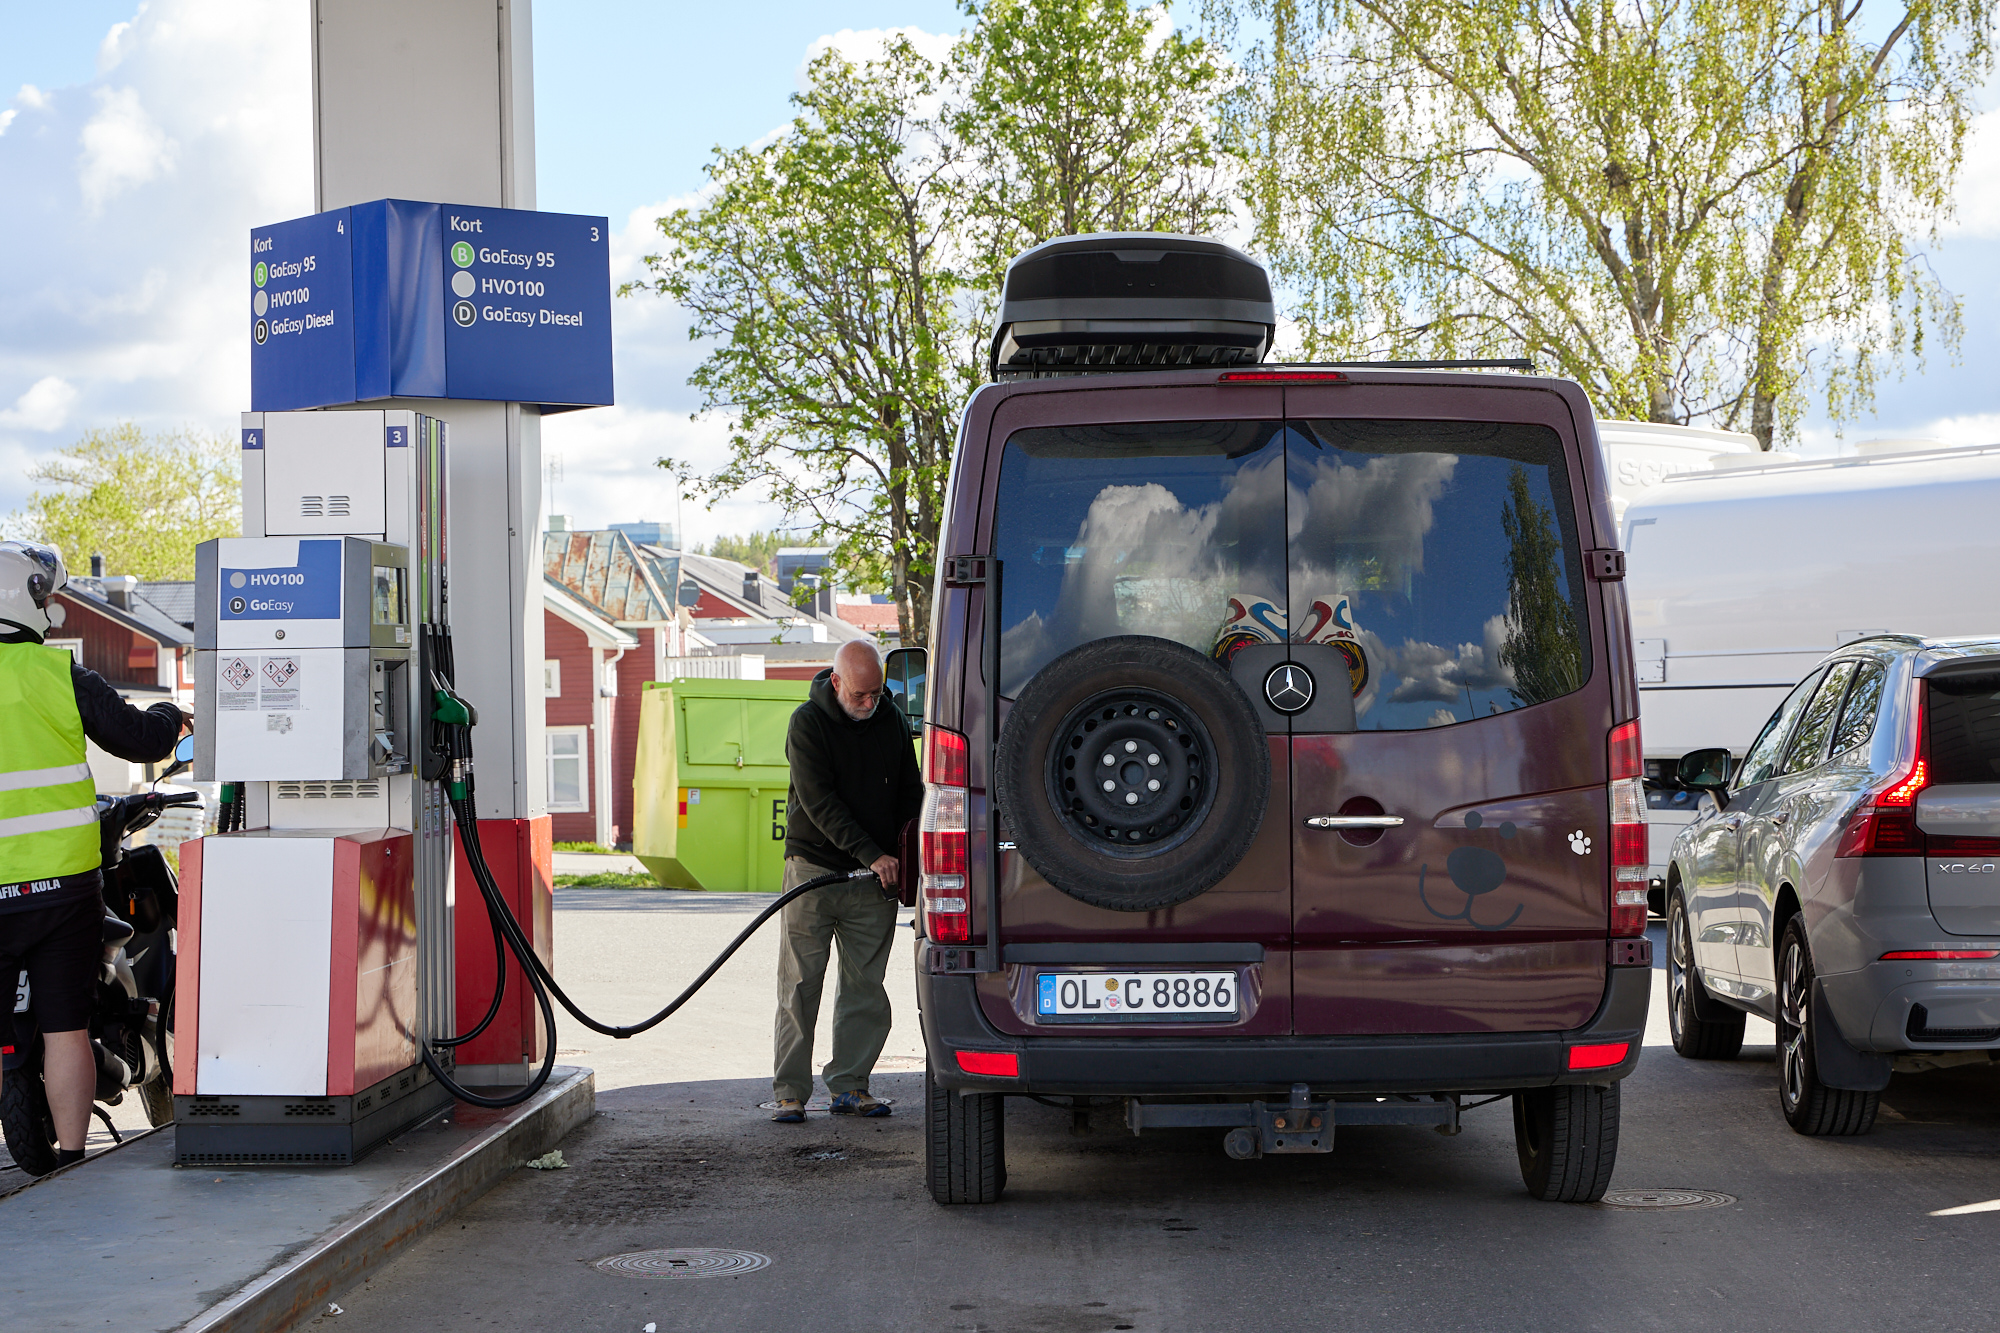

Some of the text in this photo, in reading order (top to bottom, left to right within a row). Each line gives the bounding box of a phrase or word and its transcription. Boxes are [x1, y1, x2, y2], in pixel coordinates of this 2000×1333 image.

[337, 220, 344, 235] 4
[450, 215, 483, 233] Kort
[590, 227, 599, 242] 3
[254, 237, 273, 254] Kort
[457, 247, 555, 270] B GoEasy 95
[257, 255, 316, 282] B GoEasy 95
[481, 278, 545, 297] HVO100
[270, 287, 310, 309] HVO100
[257, 309, 334, 340] D GoEasy Diesel
[459, 305, 583, 328] D GoEasy Diesel
[246, 433, 257, 446] 4
[392, 430, 402, 444] 3
[250, 573, 305, 586] HVO100
[234, 599, 294, 614] D GoEasy
[0, 878, 61, 900] FIK KULA
[1044, 977, 1231, 1009] D OL C 8886
